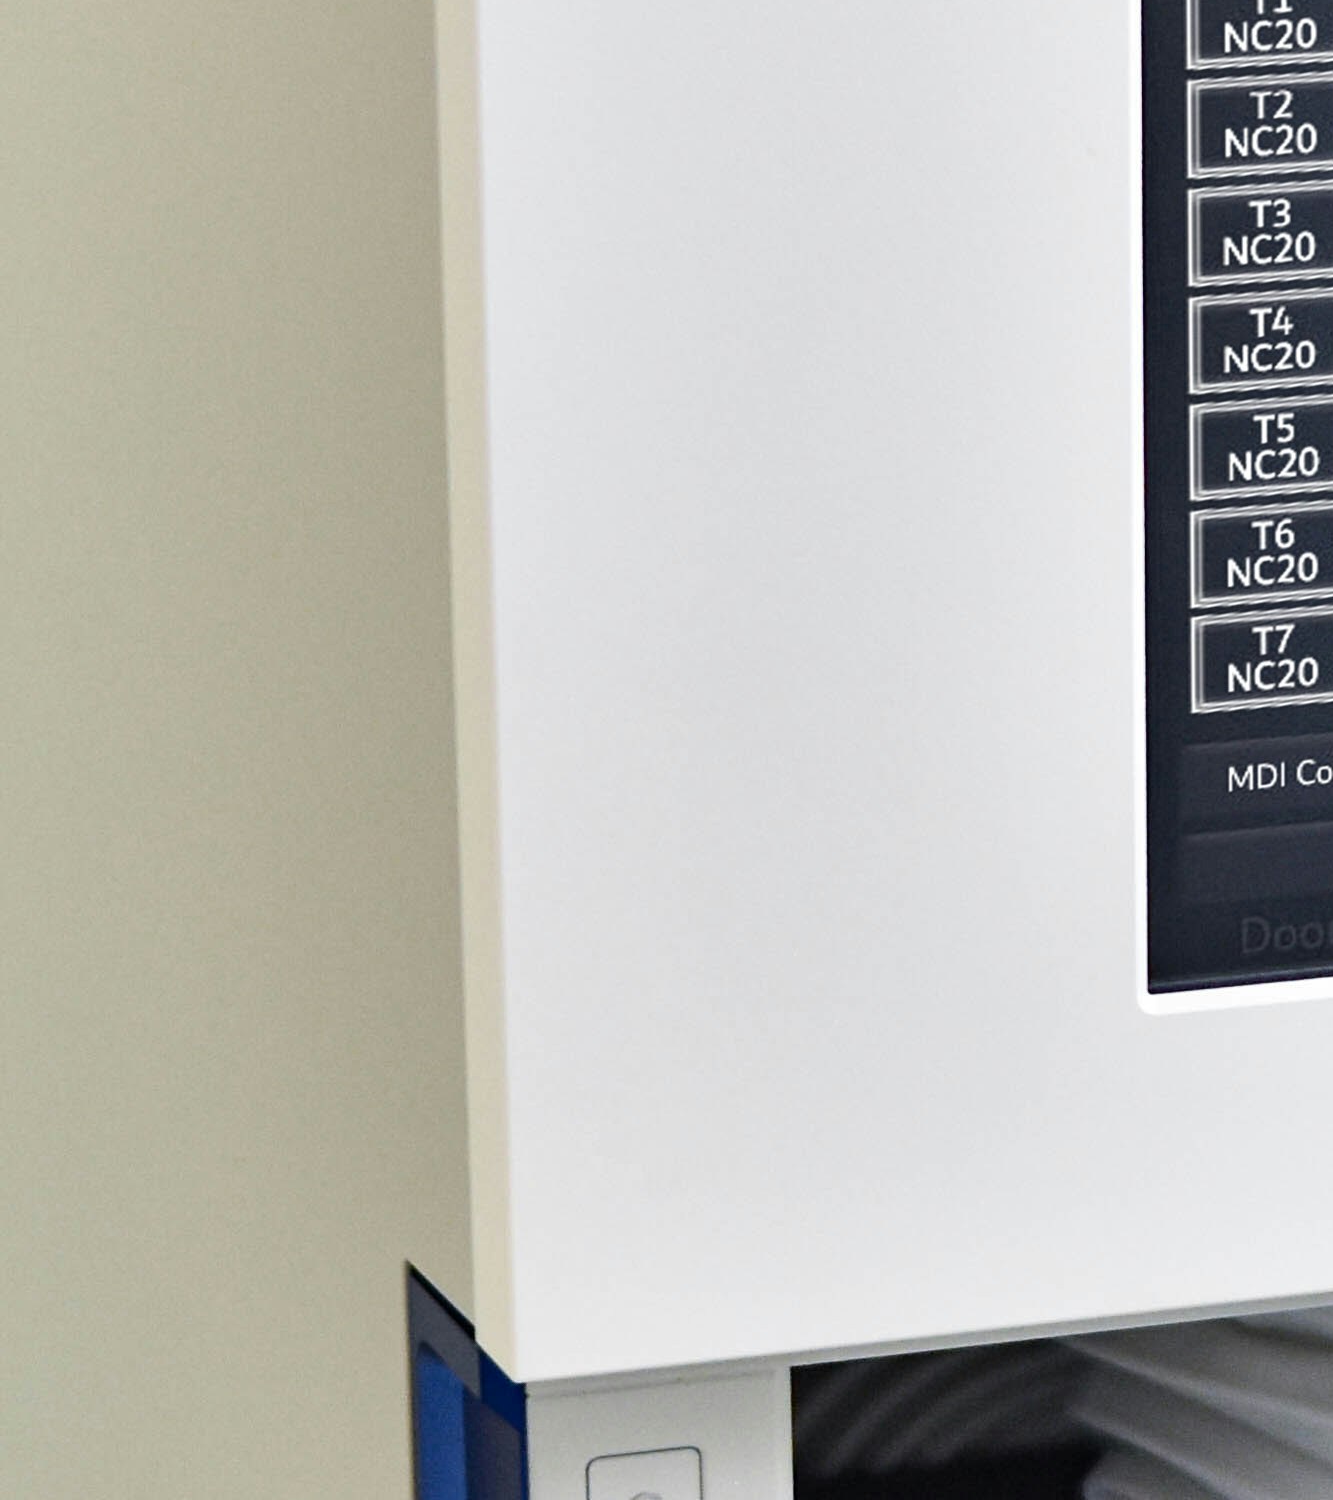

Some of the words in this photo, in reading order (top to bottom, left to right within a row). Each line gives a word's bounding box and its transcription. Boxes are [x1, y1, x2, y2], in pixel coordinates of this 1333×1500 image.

[1224, 18, 1318, 54] NC20
[1250, 88, 1293, 120] T2
[1224, 123, 1318, 160] NC20
[1249, 198, 1293, 230] T3
[1223, 232, 1316, 267] NC20
[1250, 307, 1294, 340] T4
[1224, 340, 1316, 375] NC20
[1253, 413, 1295, 444] T5
[1227, 446, 1320, 482] NC20
[1252, 519, 1295, 551] T6
[1227, 553, 1318, 589] NC20
[1253, 624, 1295, 657] T7
[1227, 658, 1318, 695] NC20
[1229, 762, 1285, 791] MDI
